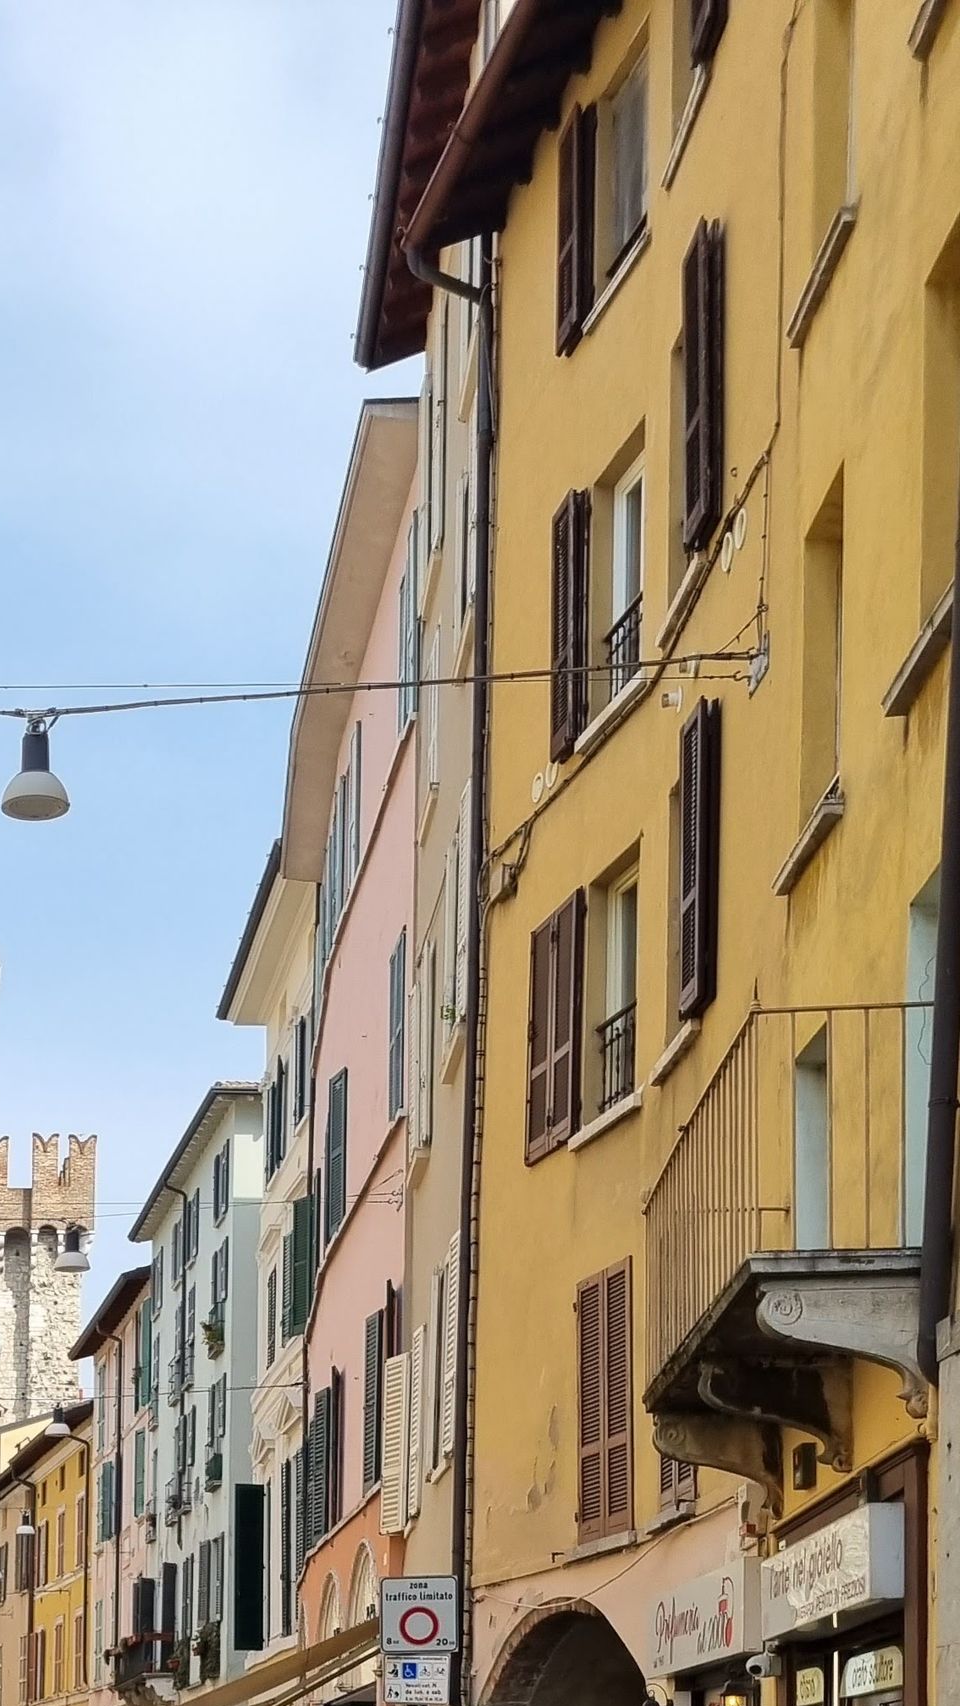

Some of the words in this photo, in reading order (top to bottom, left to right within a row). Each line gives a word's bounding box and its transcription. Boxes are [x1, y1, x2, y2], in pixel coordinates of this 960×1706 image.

[385, 1592, 417, 1601] traffico
[420, 1591, 453, 1600] limitato
[435, 1638, 448, 1646] 20
